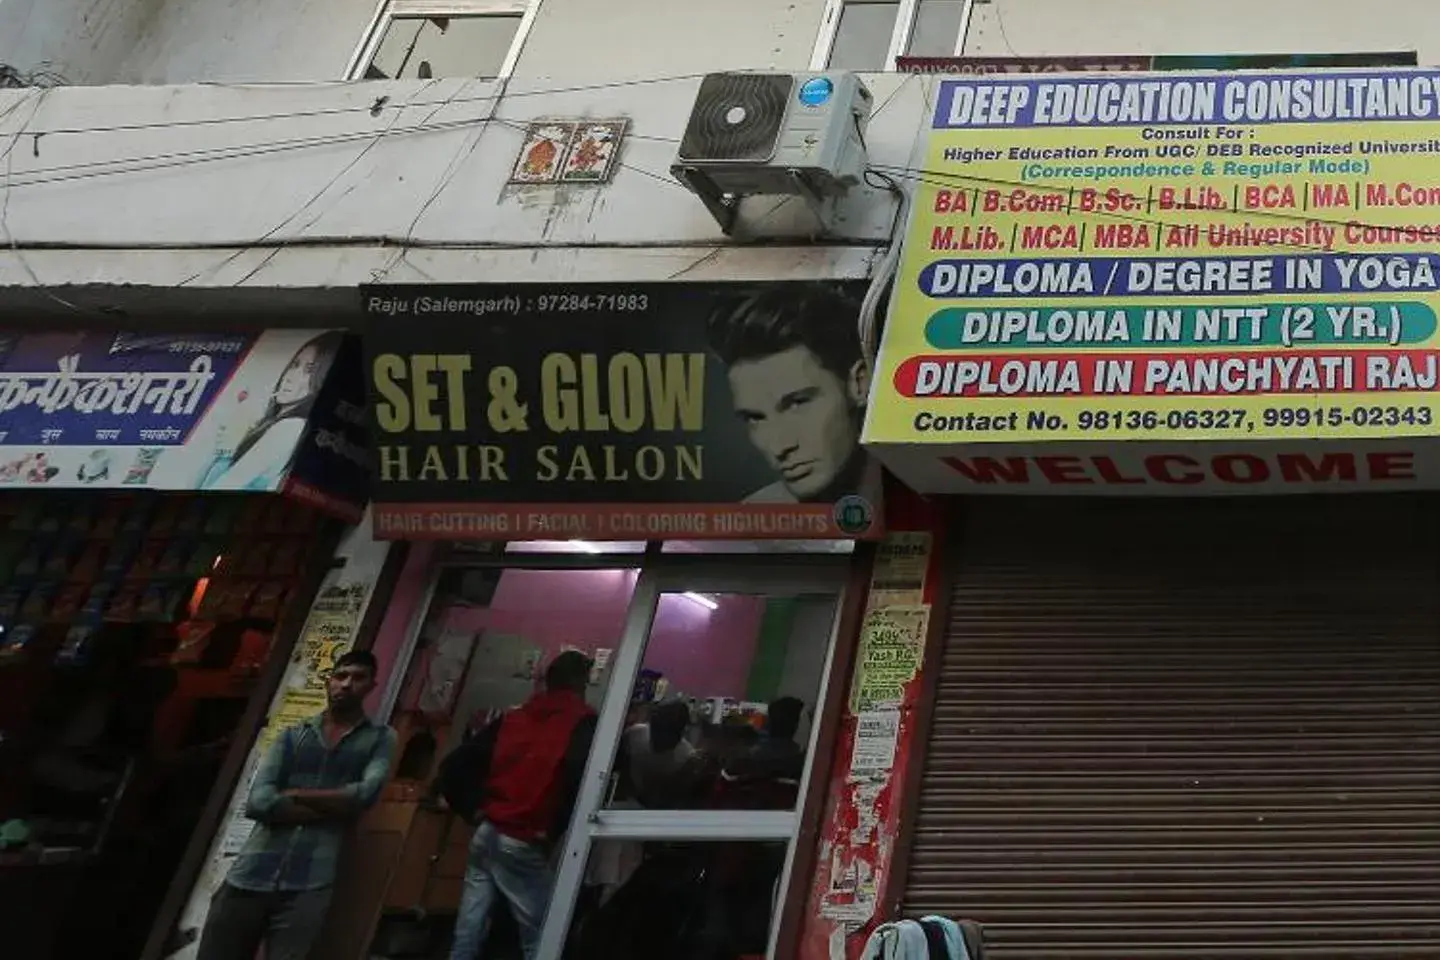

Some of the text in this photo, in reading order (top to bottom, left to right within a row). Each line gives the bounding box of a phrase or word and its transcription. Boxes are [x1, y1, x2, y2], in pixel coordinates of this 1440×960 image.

[949, 83, 1028, 125] DEEP
[1034, 82, 1217, 123] EDUCATION
[1141, 126, 1212, 141] Consult
[1216, 126, 1245, 140] For
[944, 145, 1005, 162] Higher
[1010, 144, 1100, 158] Education
[1105, 143, 1150, 158] From
[1207, 141, 1245, 157] DEB
[1250, 141, 1353, 159] Recognized
[1021, 159, 1370, 181] (Correspondence & Regular Mode)
[1166, 224, 1199, 248] All
[1207, 224, 1335, 251] University
[931, 262, 1094, 295] DIPLOMA
[1128, 260, 1273, 292] DEGREE
[1287, 259, 1321, 289] IN
[1333, 257, 1437, 288] YOGA
[368, 298, 409, 315] Raju
[414, 297, 520, 315] (Salemgarh)
[538, 295, 648, 313] 97284-71983
[962, 307, 1401, 346] DIPLOMA IN NTT (2 YR.)
[914, 356, 1438, 397] DIPLOMA IN PANCHYATI RAJ
[373, 352, 705, 433] SET & GLOW
[914, 408, 1432, 434] Contact No. 98136-06327, 99915-02343
[379, 447, 508, 481] HAIR
[537, 446, 705, 480] SALON
[941, 450, 1416, 485] WELCOME
[379, 513, 424, 531] HAIR
[430, 513, 507, 531] CUTTING
[527, 513, 592, 531] FACIAL
[610, 513, 707, 531] COLORING
[713, 513, 828, 532] HIGHLIGHTS
